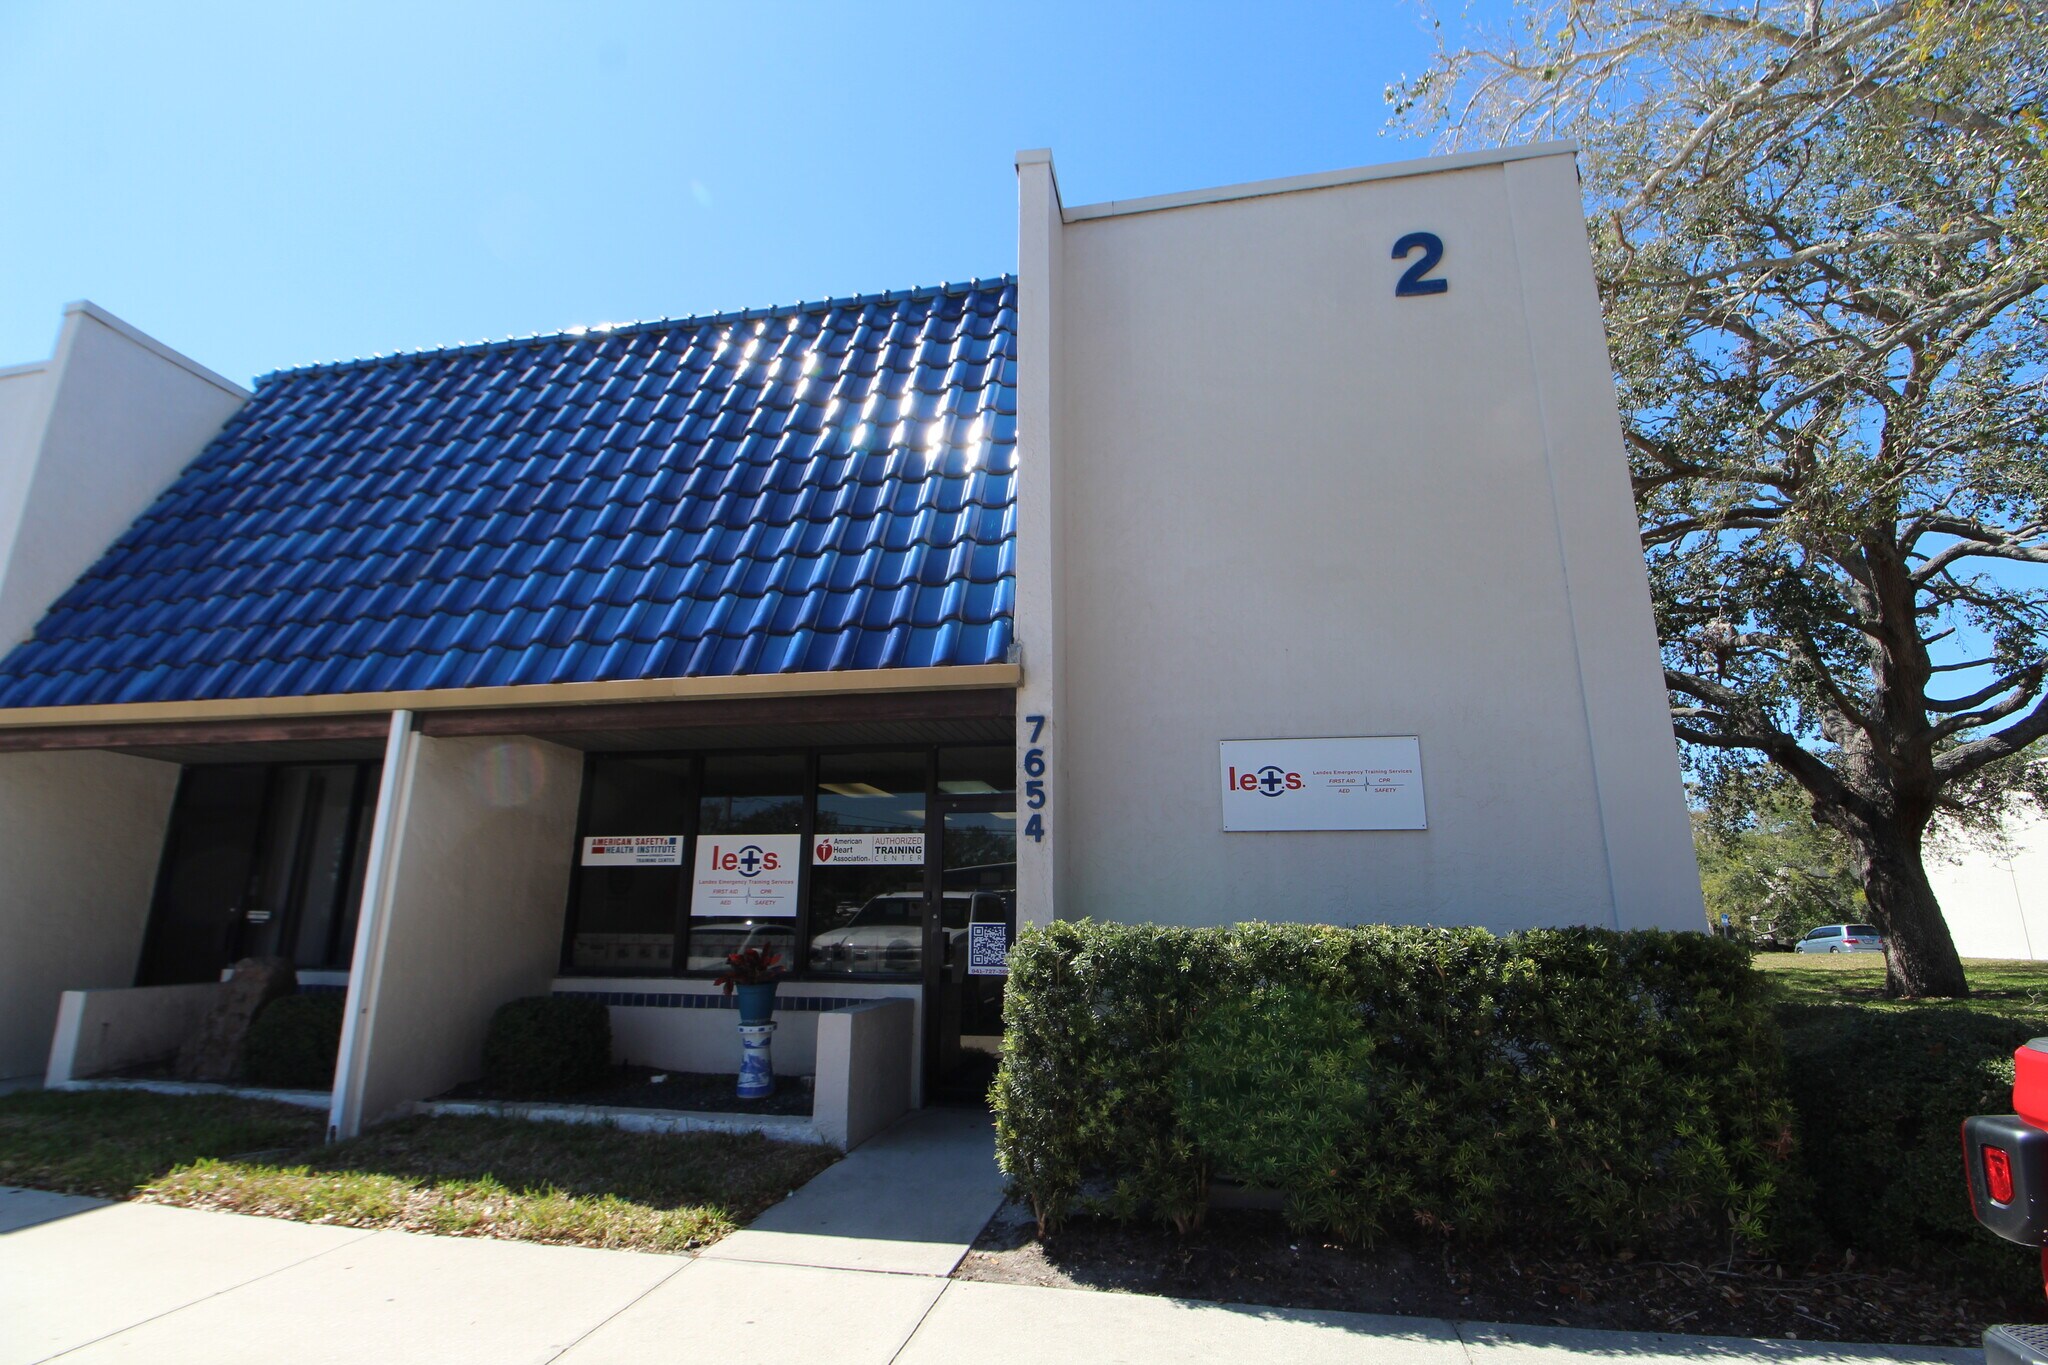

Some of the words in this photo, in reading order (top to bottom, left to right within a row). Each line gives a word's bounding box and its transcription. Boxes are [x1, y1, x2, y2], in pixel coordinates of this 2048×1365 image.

[1391, 231, 1448, 297] 2
[1024, 715, 1045, 843] 7654
[875, 837, 922, 845] AUTHORIZED
[636, 845, 676, 853] INSTITUTE
[875, 846, 922, 854] TRAINING
